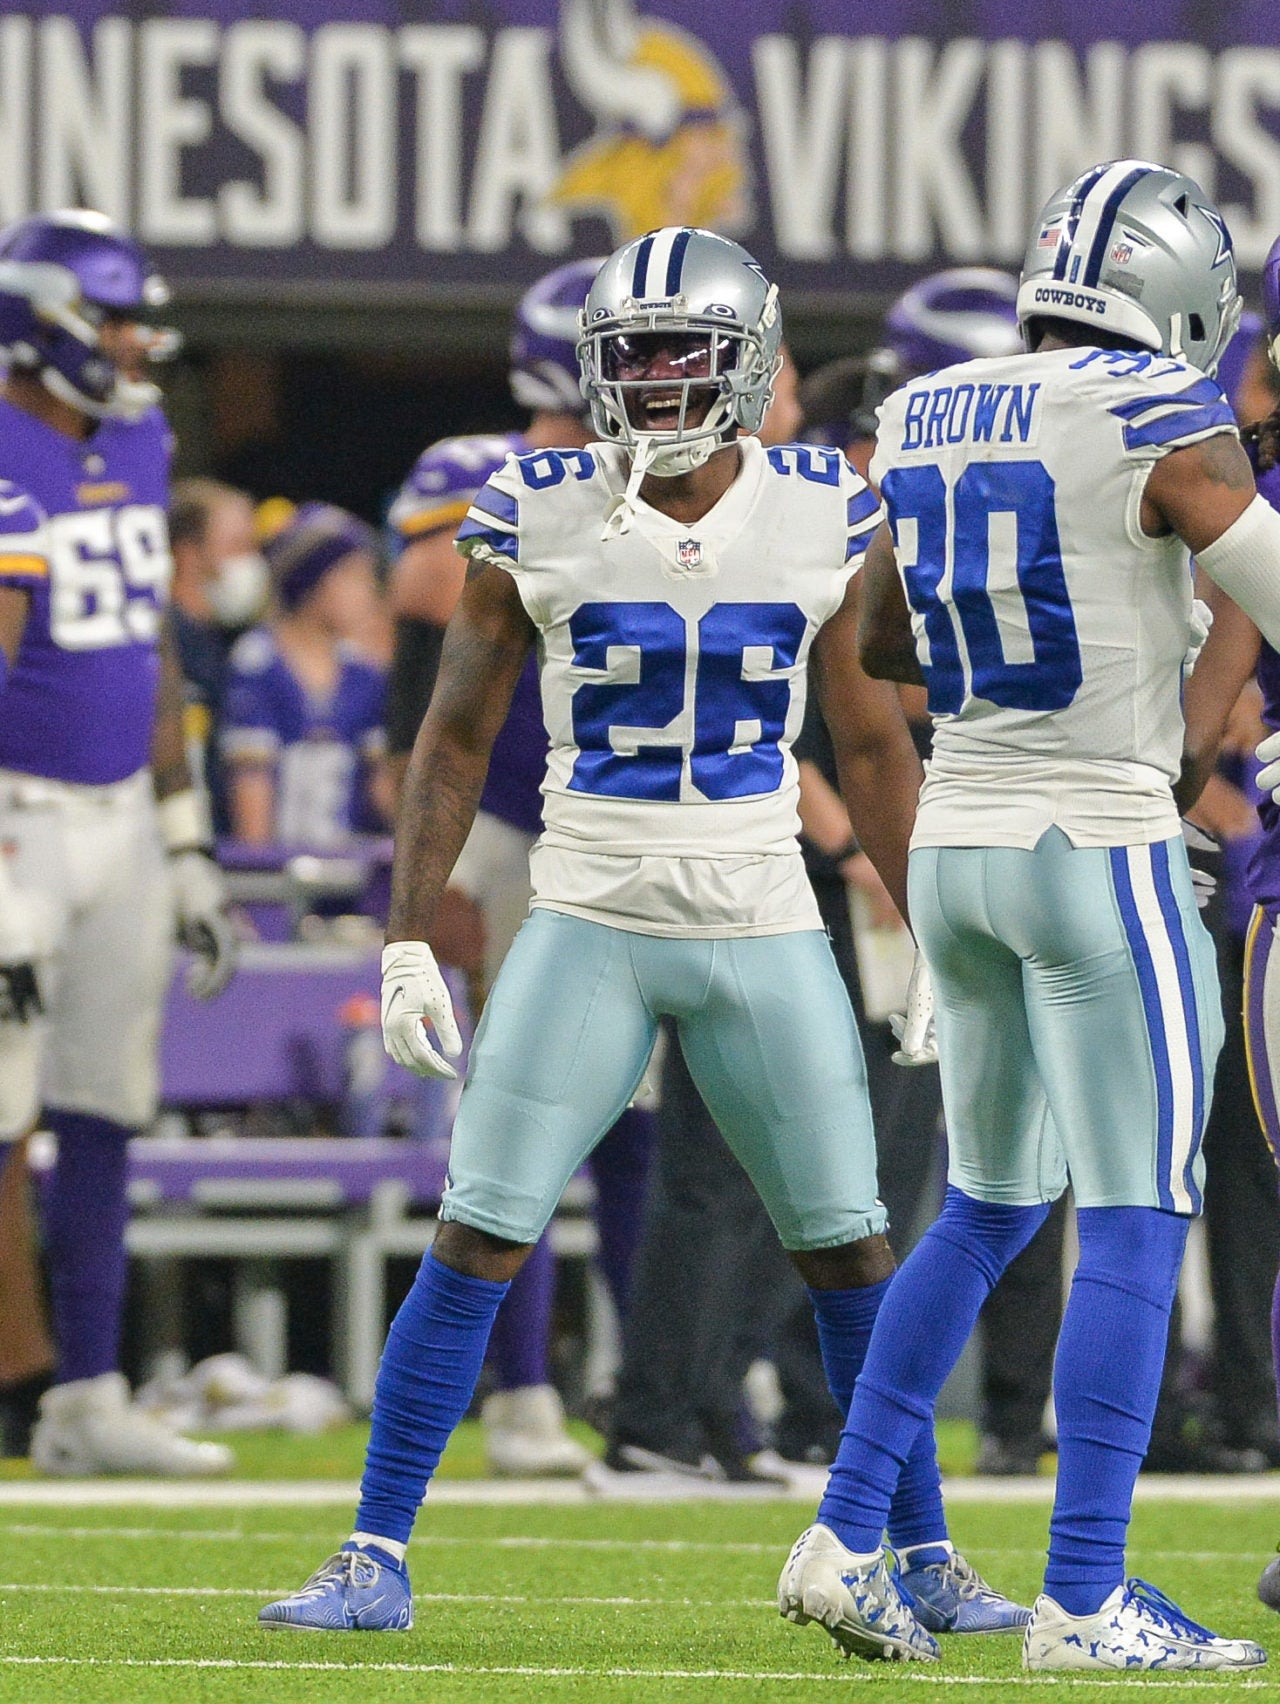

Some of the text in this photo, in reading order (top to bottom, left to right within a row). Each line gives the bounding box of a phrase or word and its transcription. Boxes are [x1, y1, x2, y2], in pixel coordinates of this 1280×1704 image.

[1034, 287, 1107, 314] COWBOYS
[901, 382, 1042, 451] BROWN
[50, 505, 173, 651] 69
[880, 459, 1084, 716] 30
[566, 602, 808, 802] 26
